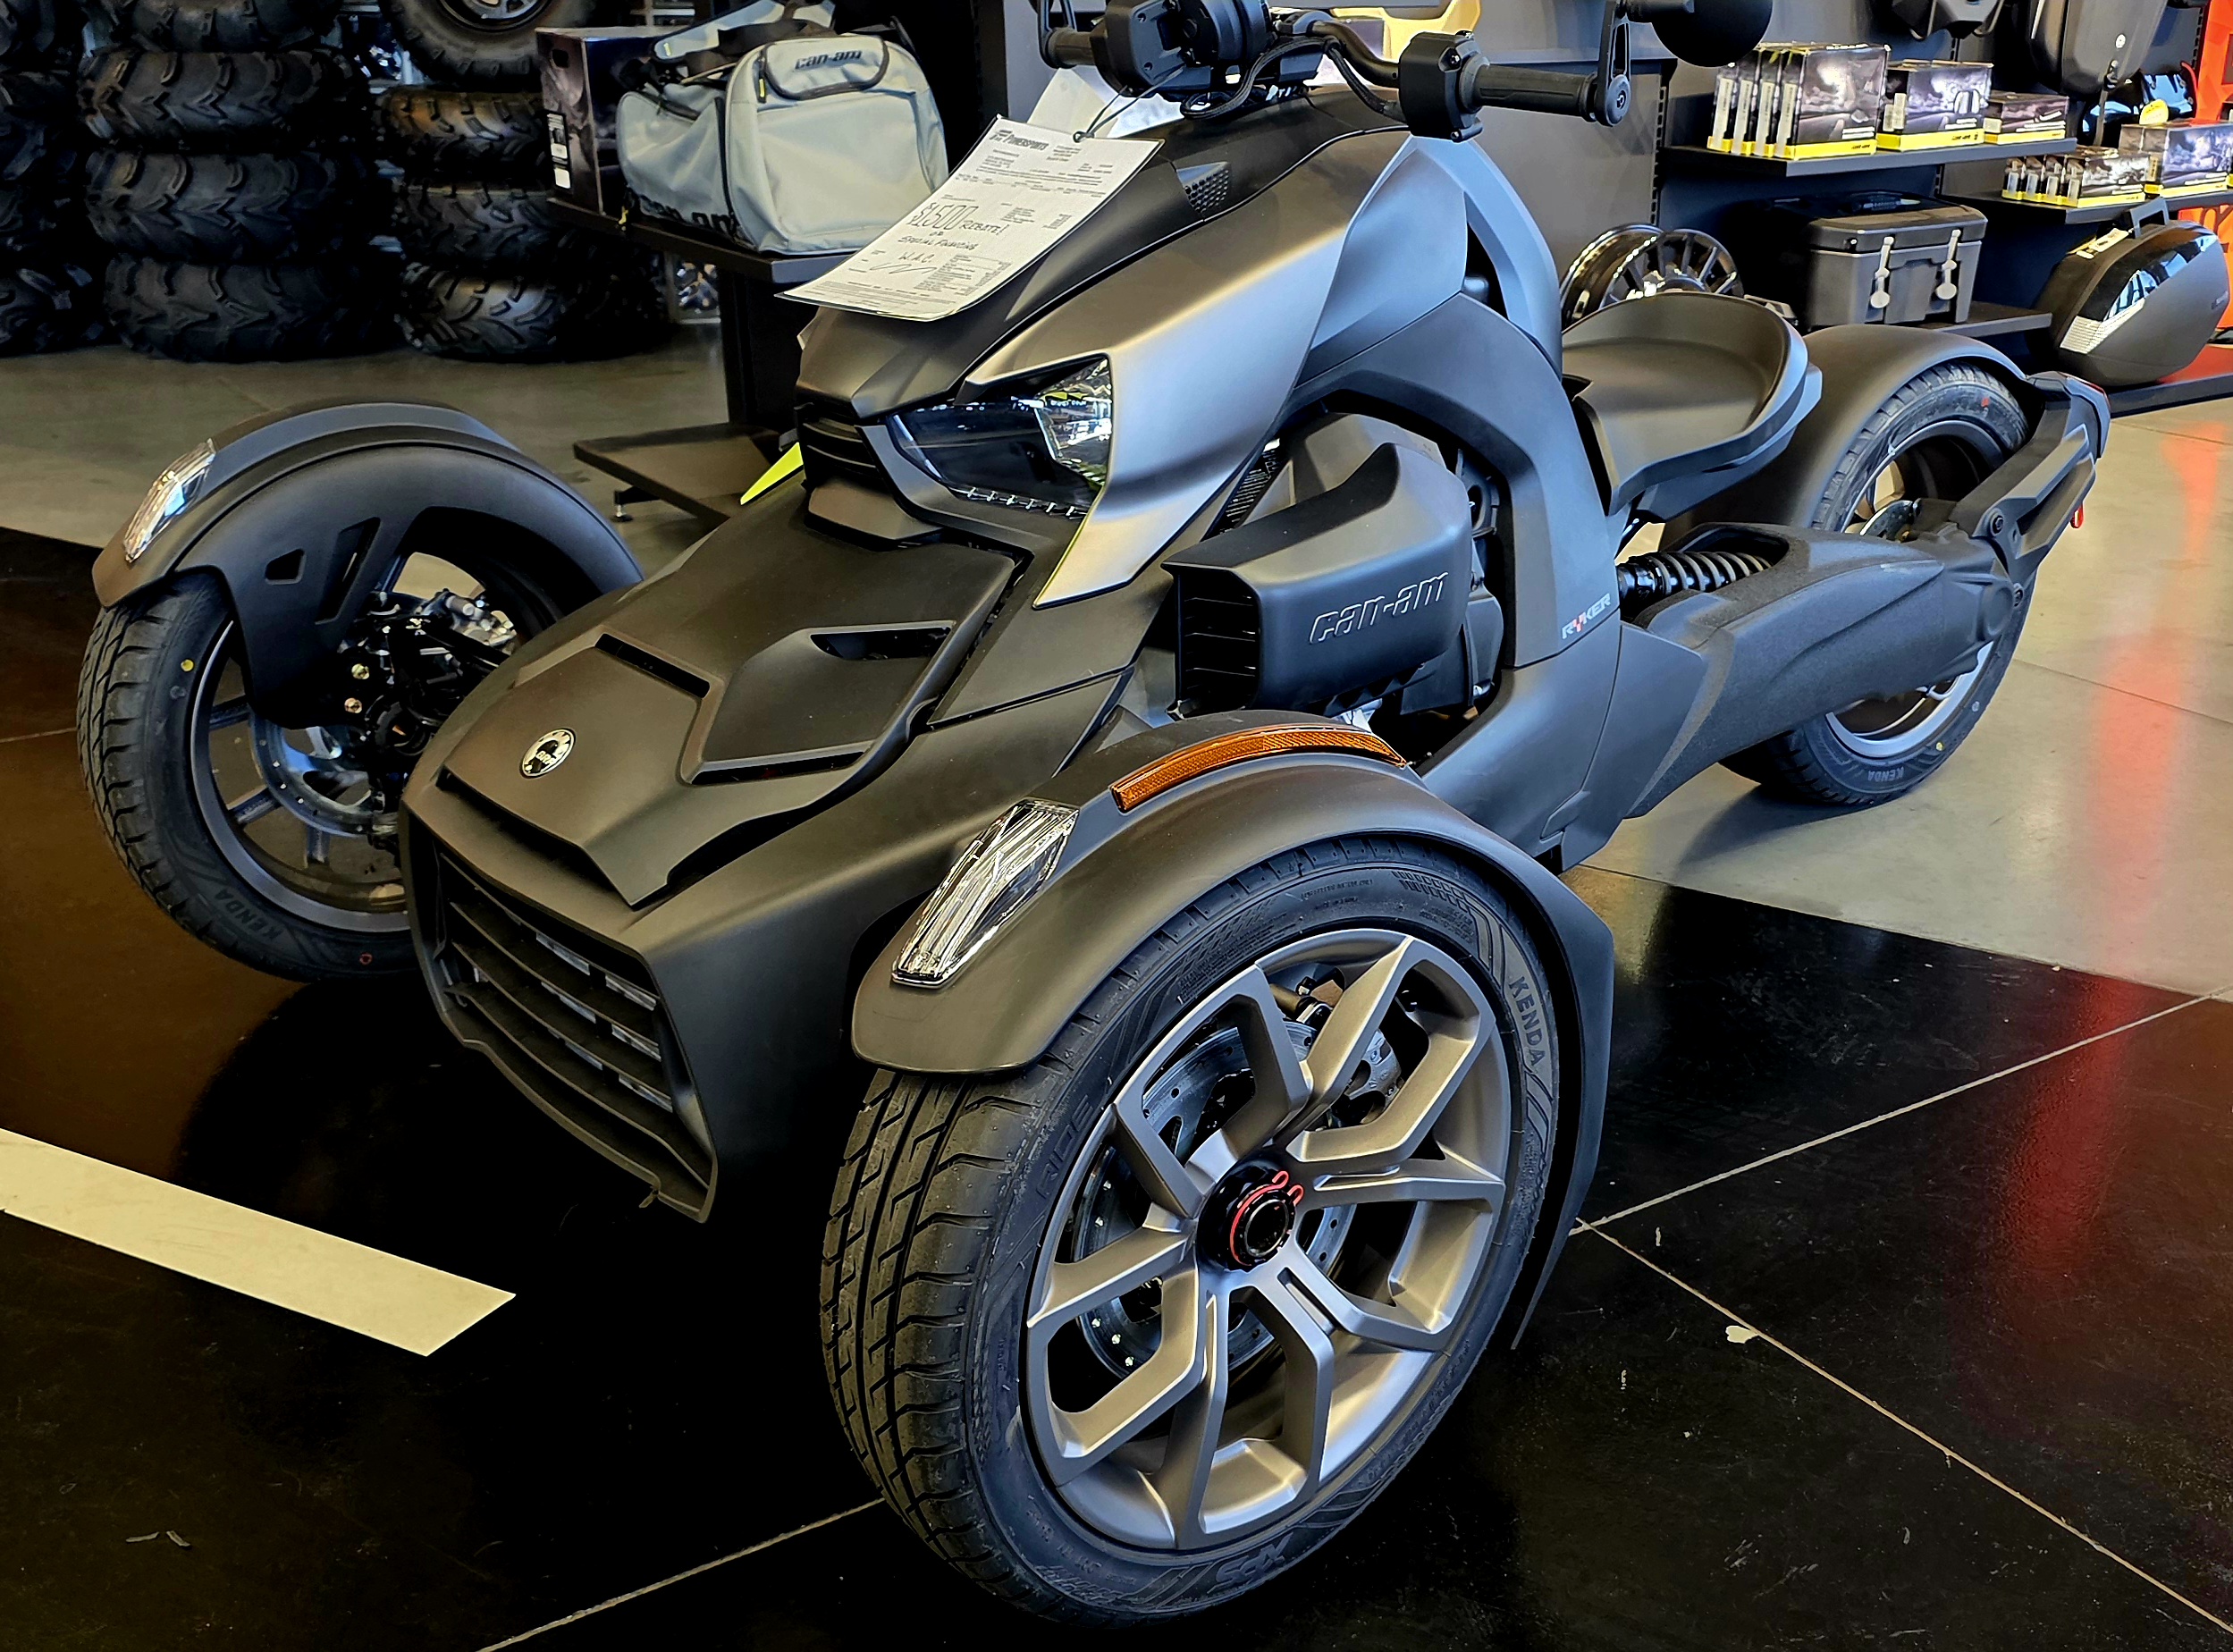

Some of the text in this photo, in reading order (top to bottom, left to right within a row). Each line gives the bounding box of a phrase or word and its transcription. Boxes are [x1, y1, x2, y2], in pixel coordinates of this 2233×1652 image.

[794, 50, 864, 69] can-am
[906, 202, 980, 231] $1500
[1309, 571, 1449, 645] can-am
[1561, 593, 1612, 640] RYKER
[1867, 765, 1905, 782] KENDA
[214, 888, 284, 941] KENDA
[1508, 975, 1546, 1066] KENDA
[1206, 1530, 1294, 1595] XPS
